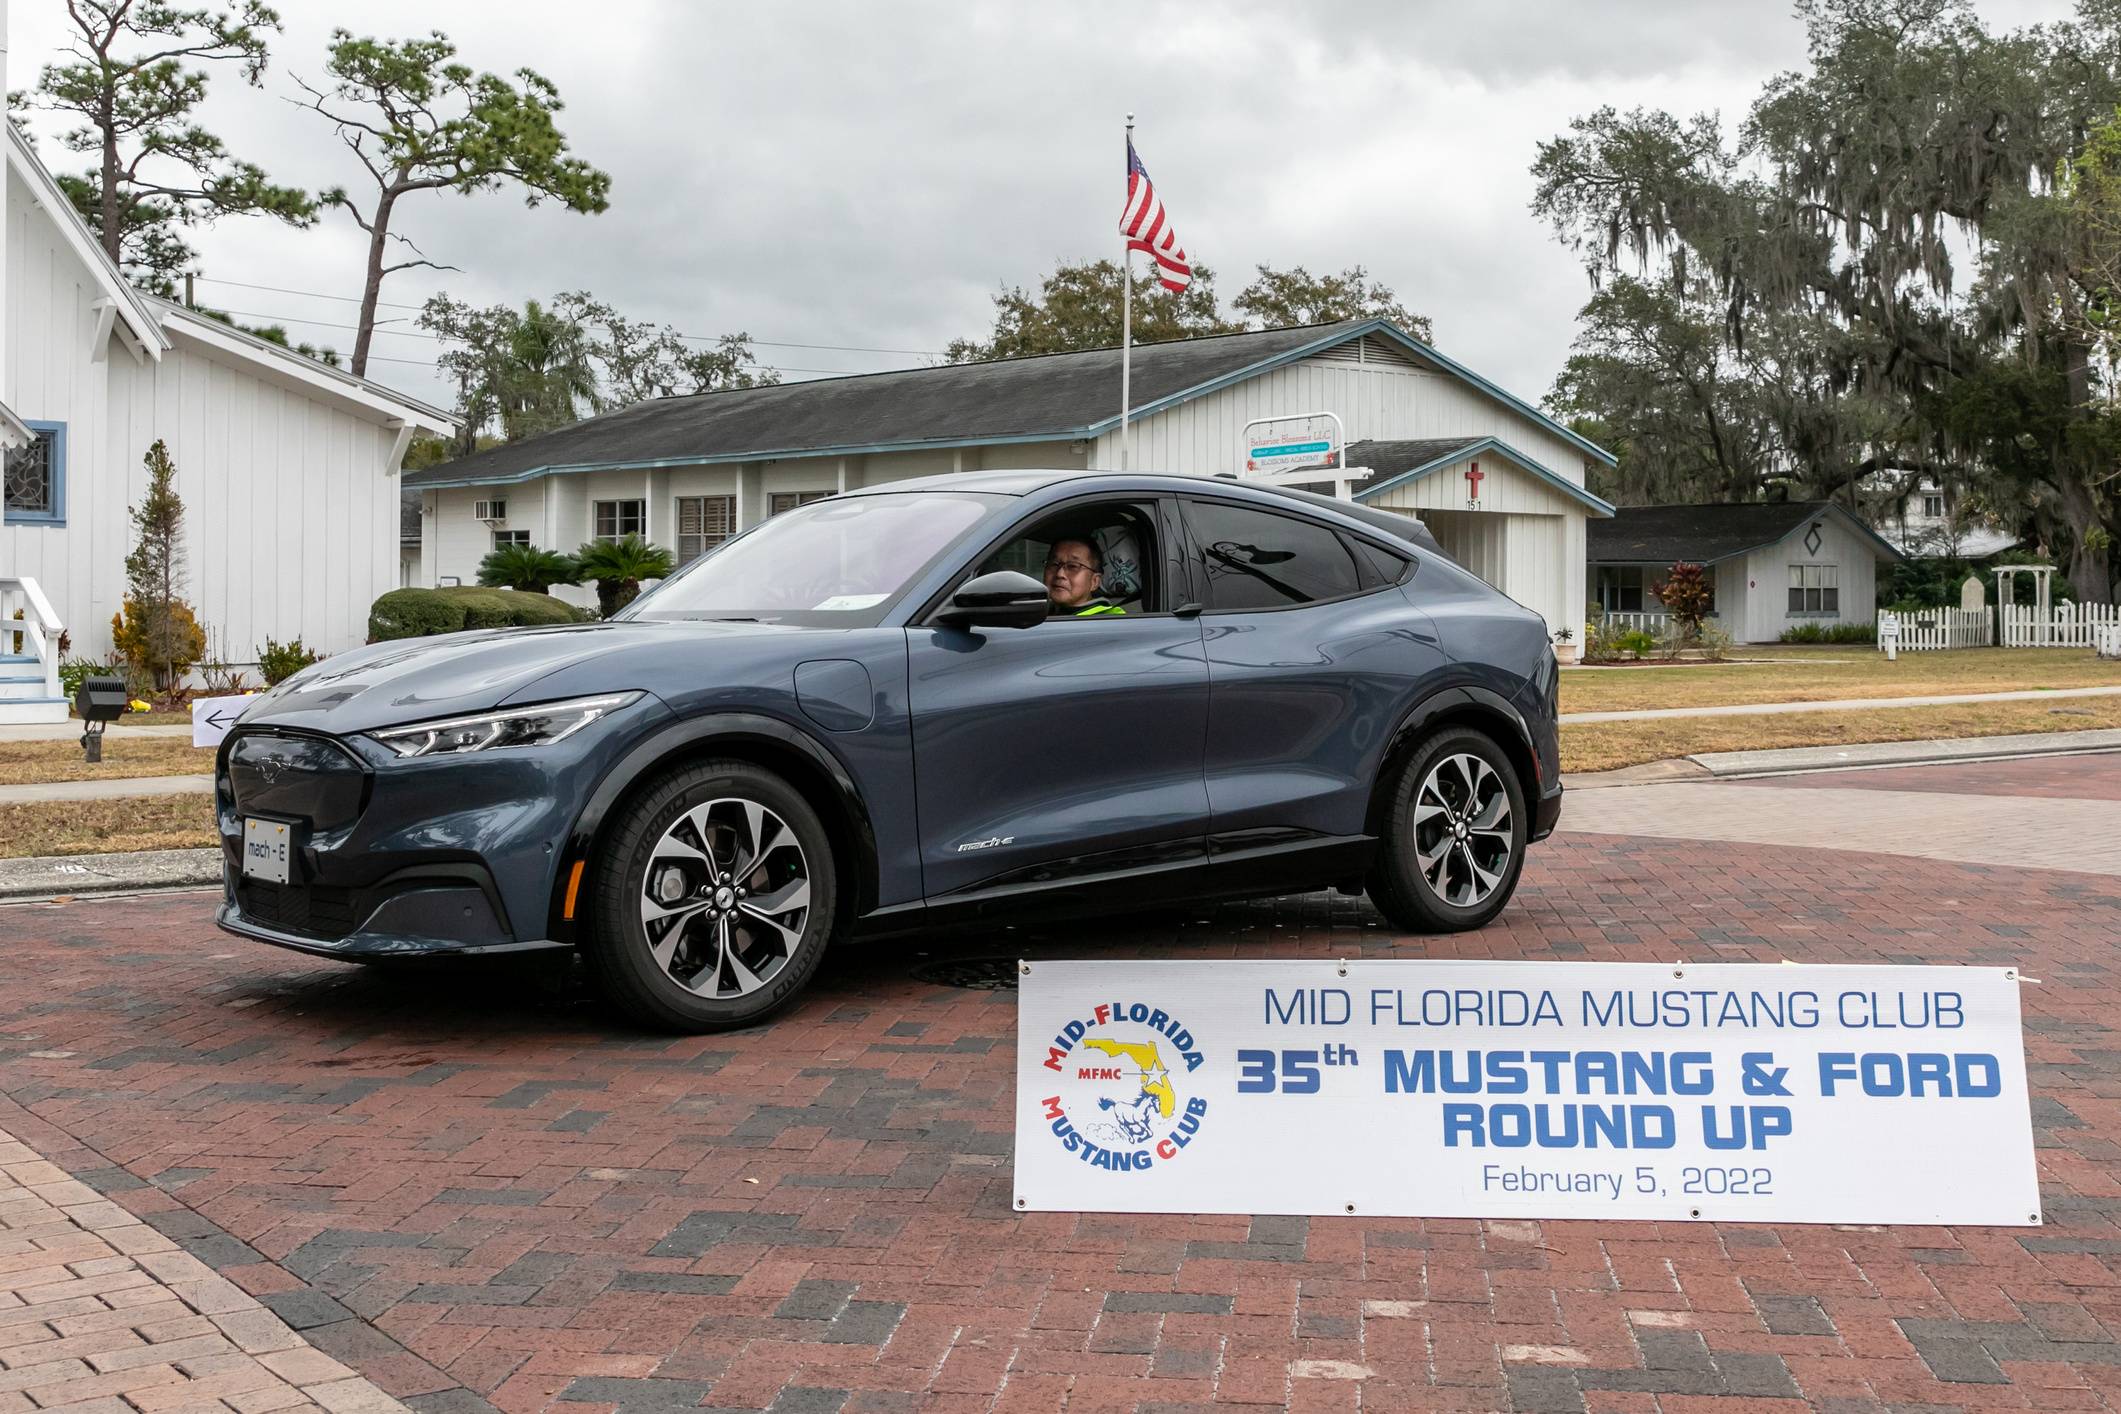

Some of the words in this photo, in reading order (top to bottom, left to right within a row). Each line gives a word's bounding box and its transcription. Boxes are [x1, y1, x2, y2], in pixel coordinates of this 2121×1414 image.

[248, 840, 270, 859] mach
[1265, 988, 1352, 1025] MID
[1370, 989, 1564, 1027] FLORIDA
[1582, 990, 1820, 1029] MUSTANG
[1838, 991, 1965, 1029] CLUB
[1043, 1002, 1205, 1073] MID-FLORIDA
[1077, 1067, 1122, 1080] MFMC
[1236, 1043, 1359, 1094] 35th
[1383, 1049, 1715, 1096] MUSTANG
[1740, 1051, 1795, 1097] &
[1817, 1052, 2002, 1098] FORD
[1041, 1095, 1152, 1172] MUSTANG
[1156, 1096, 1208, 1160] CLUB
[1442, 1102, 1676, 1149] ROUND
[1701, 1104, 1793, 1151] UP
[1483, 1164, 1623, 1200] February
[1635, 1166, 1667, 1197] 5,
[1682, 1167, 1774, 1195] 2022
